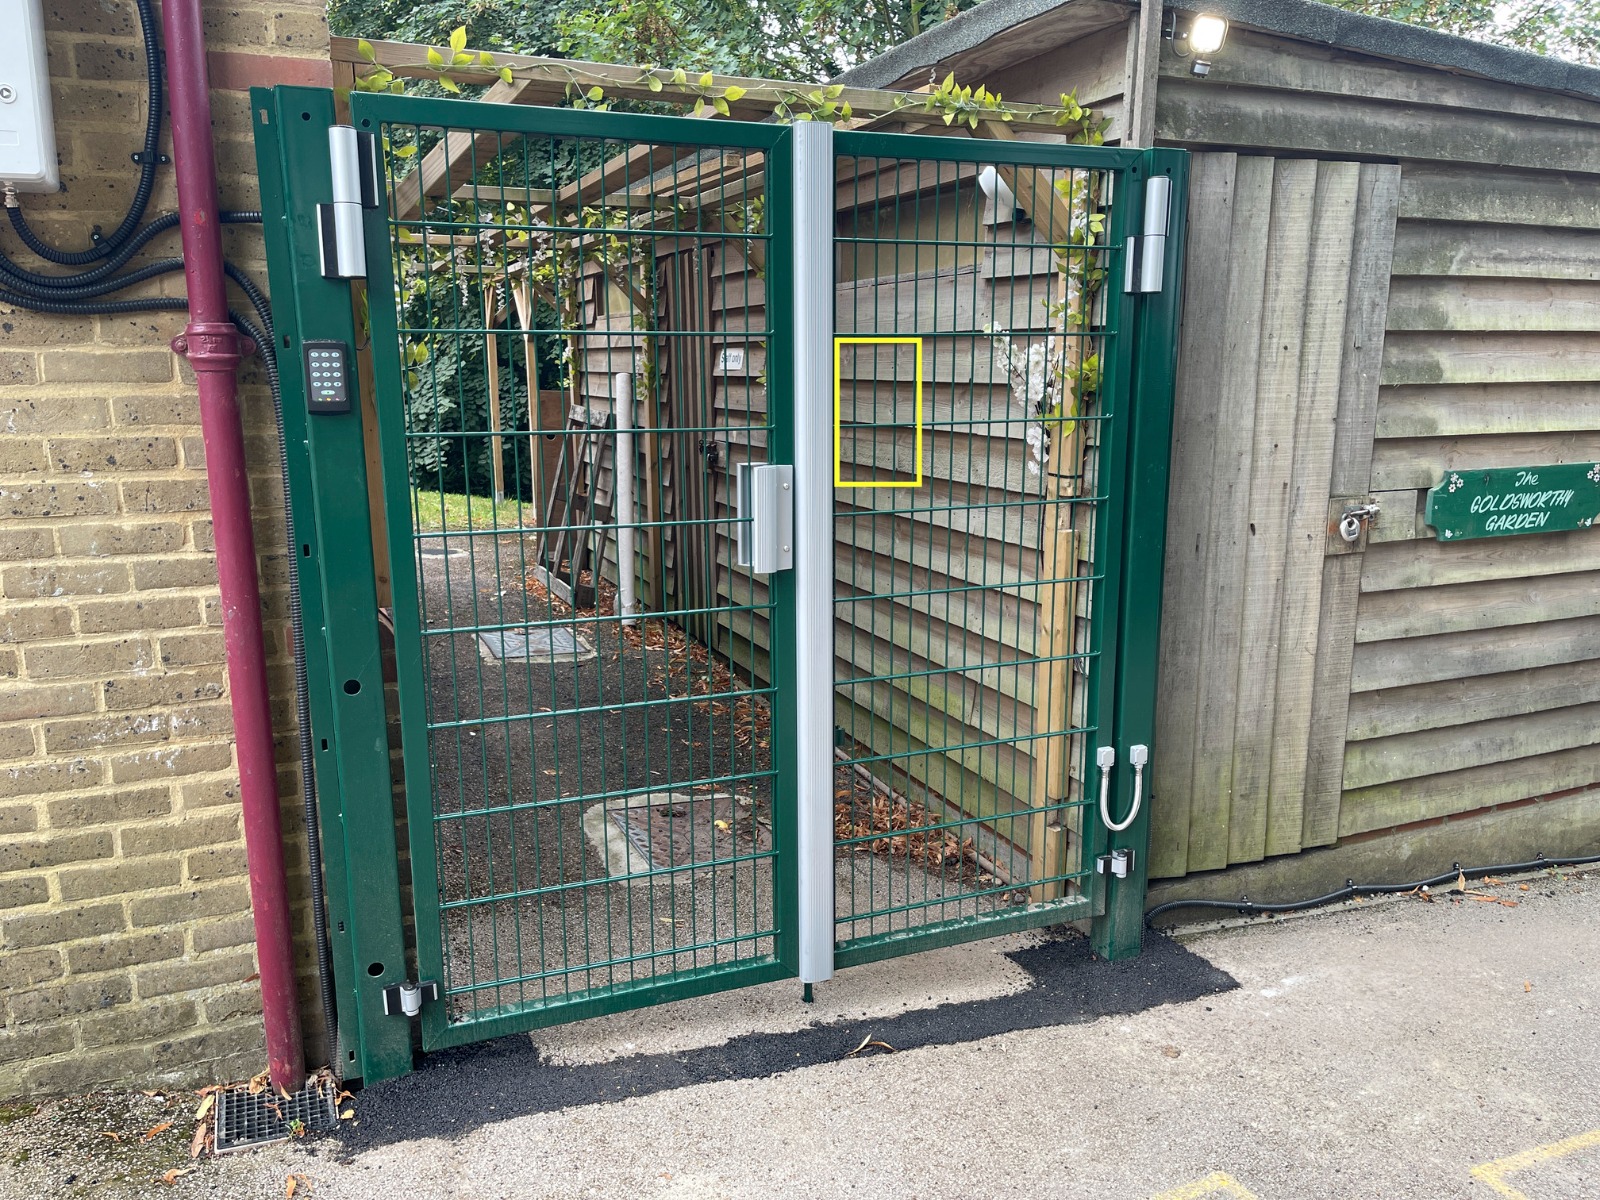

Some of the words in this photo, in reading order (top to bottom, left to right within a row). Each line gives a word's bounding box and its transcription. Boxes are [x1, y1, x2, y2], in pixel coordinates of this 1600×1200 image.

[1515, 471, 1539, 488] The
[1470, 489, 1574, 514] GOLDSWORTHY
[1485, 511, 1550, 532] GARDEN
